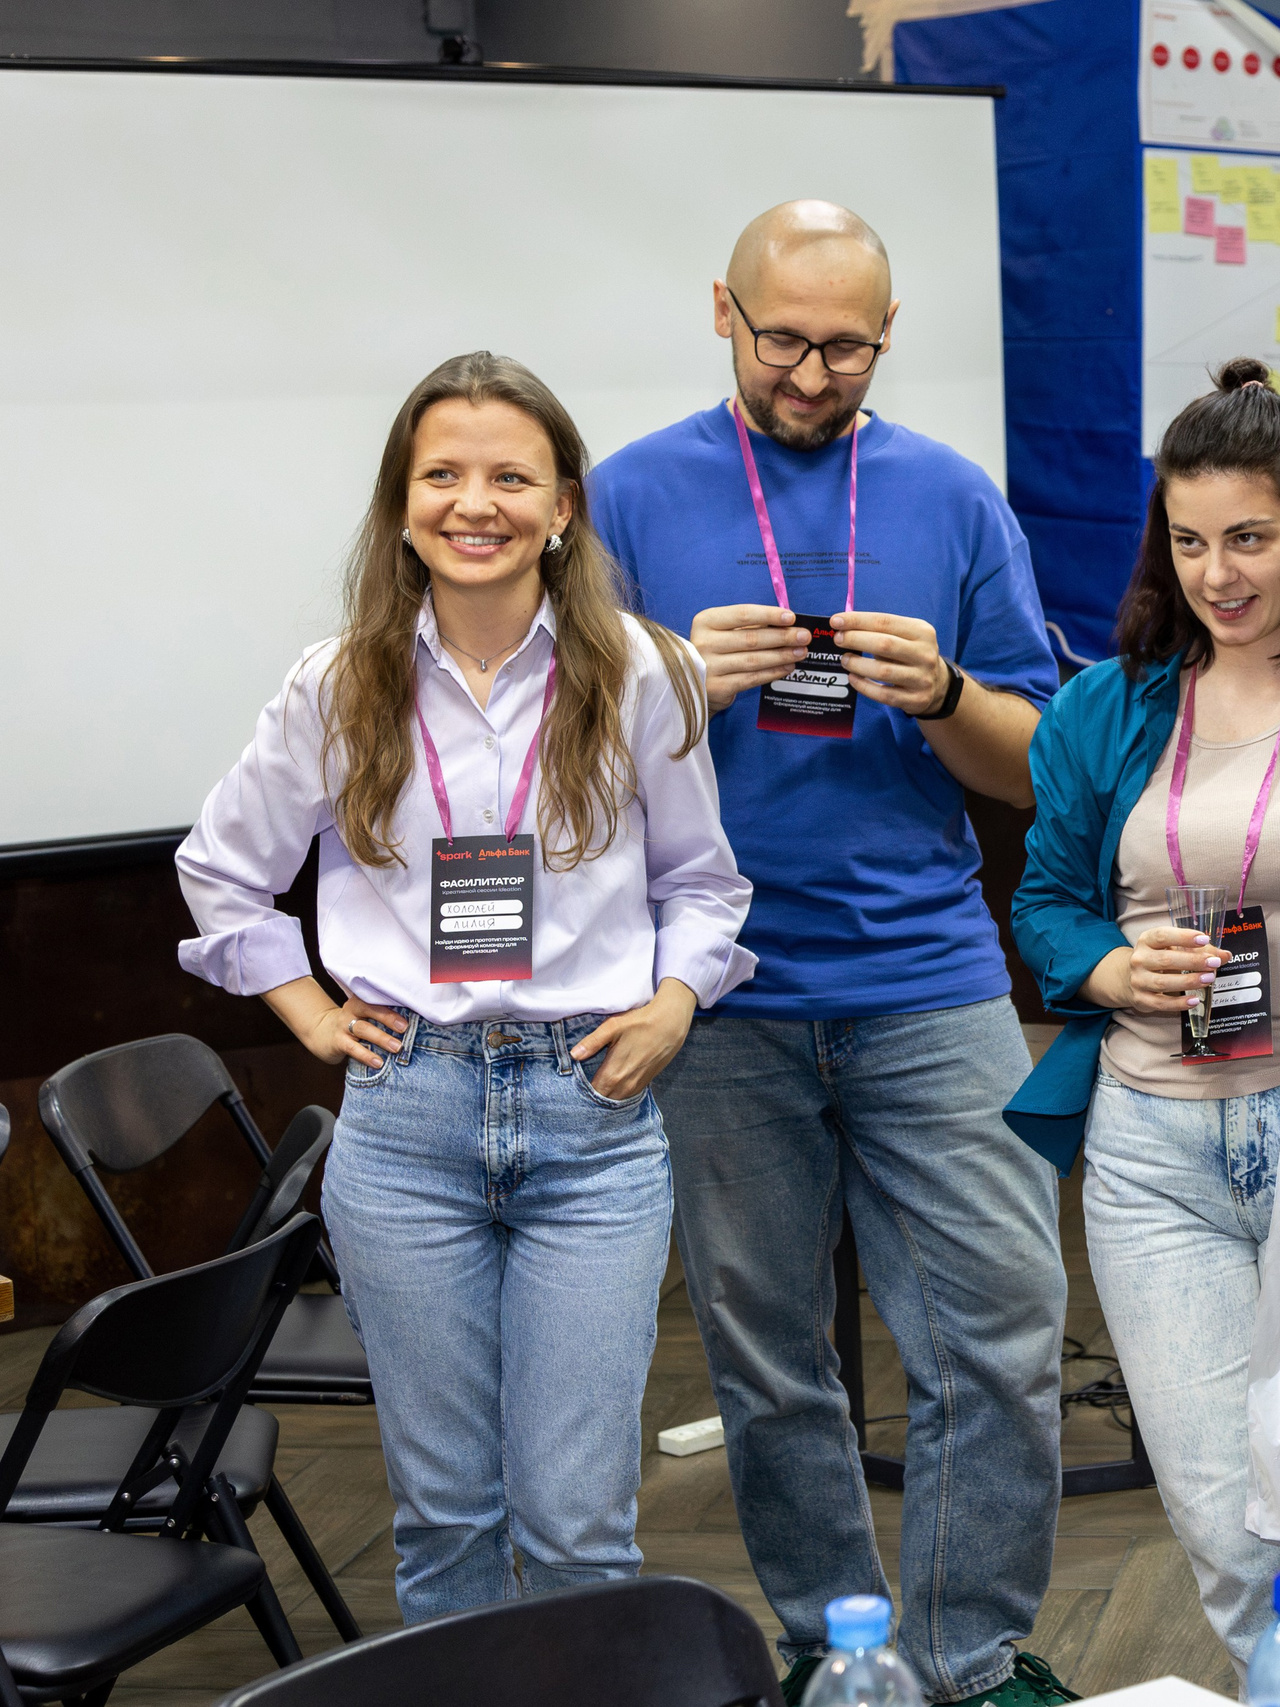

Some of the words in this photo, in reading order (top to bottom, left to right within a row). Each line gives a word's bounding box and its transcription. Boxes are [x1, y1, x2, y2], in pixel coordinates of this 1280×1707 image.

[440, 851, 472, 861] spark
[478, 848, 507, 860] Альфа
[508, 848, 530, 856] Банк
[440, 877, 524, 888] ФАСИЛИТАТОР
[448, 902, 495, 914] ХОЛОЛЕЙ
[454, 918, 495, 929] ЛИЛИЯ
[1243, 922, 1262, 932] Банк
